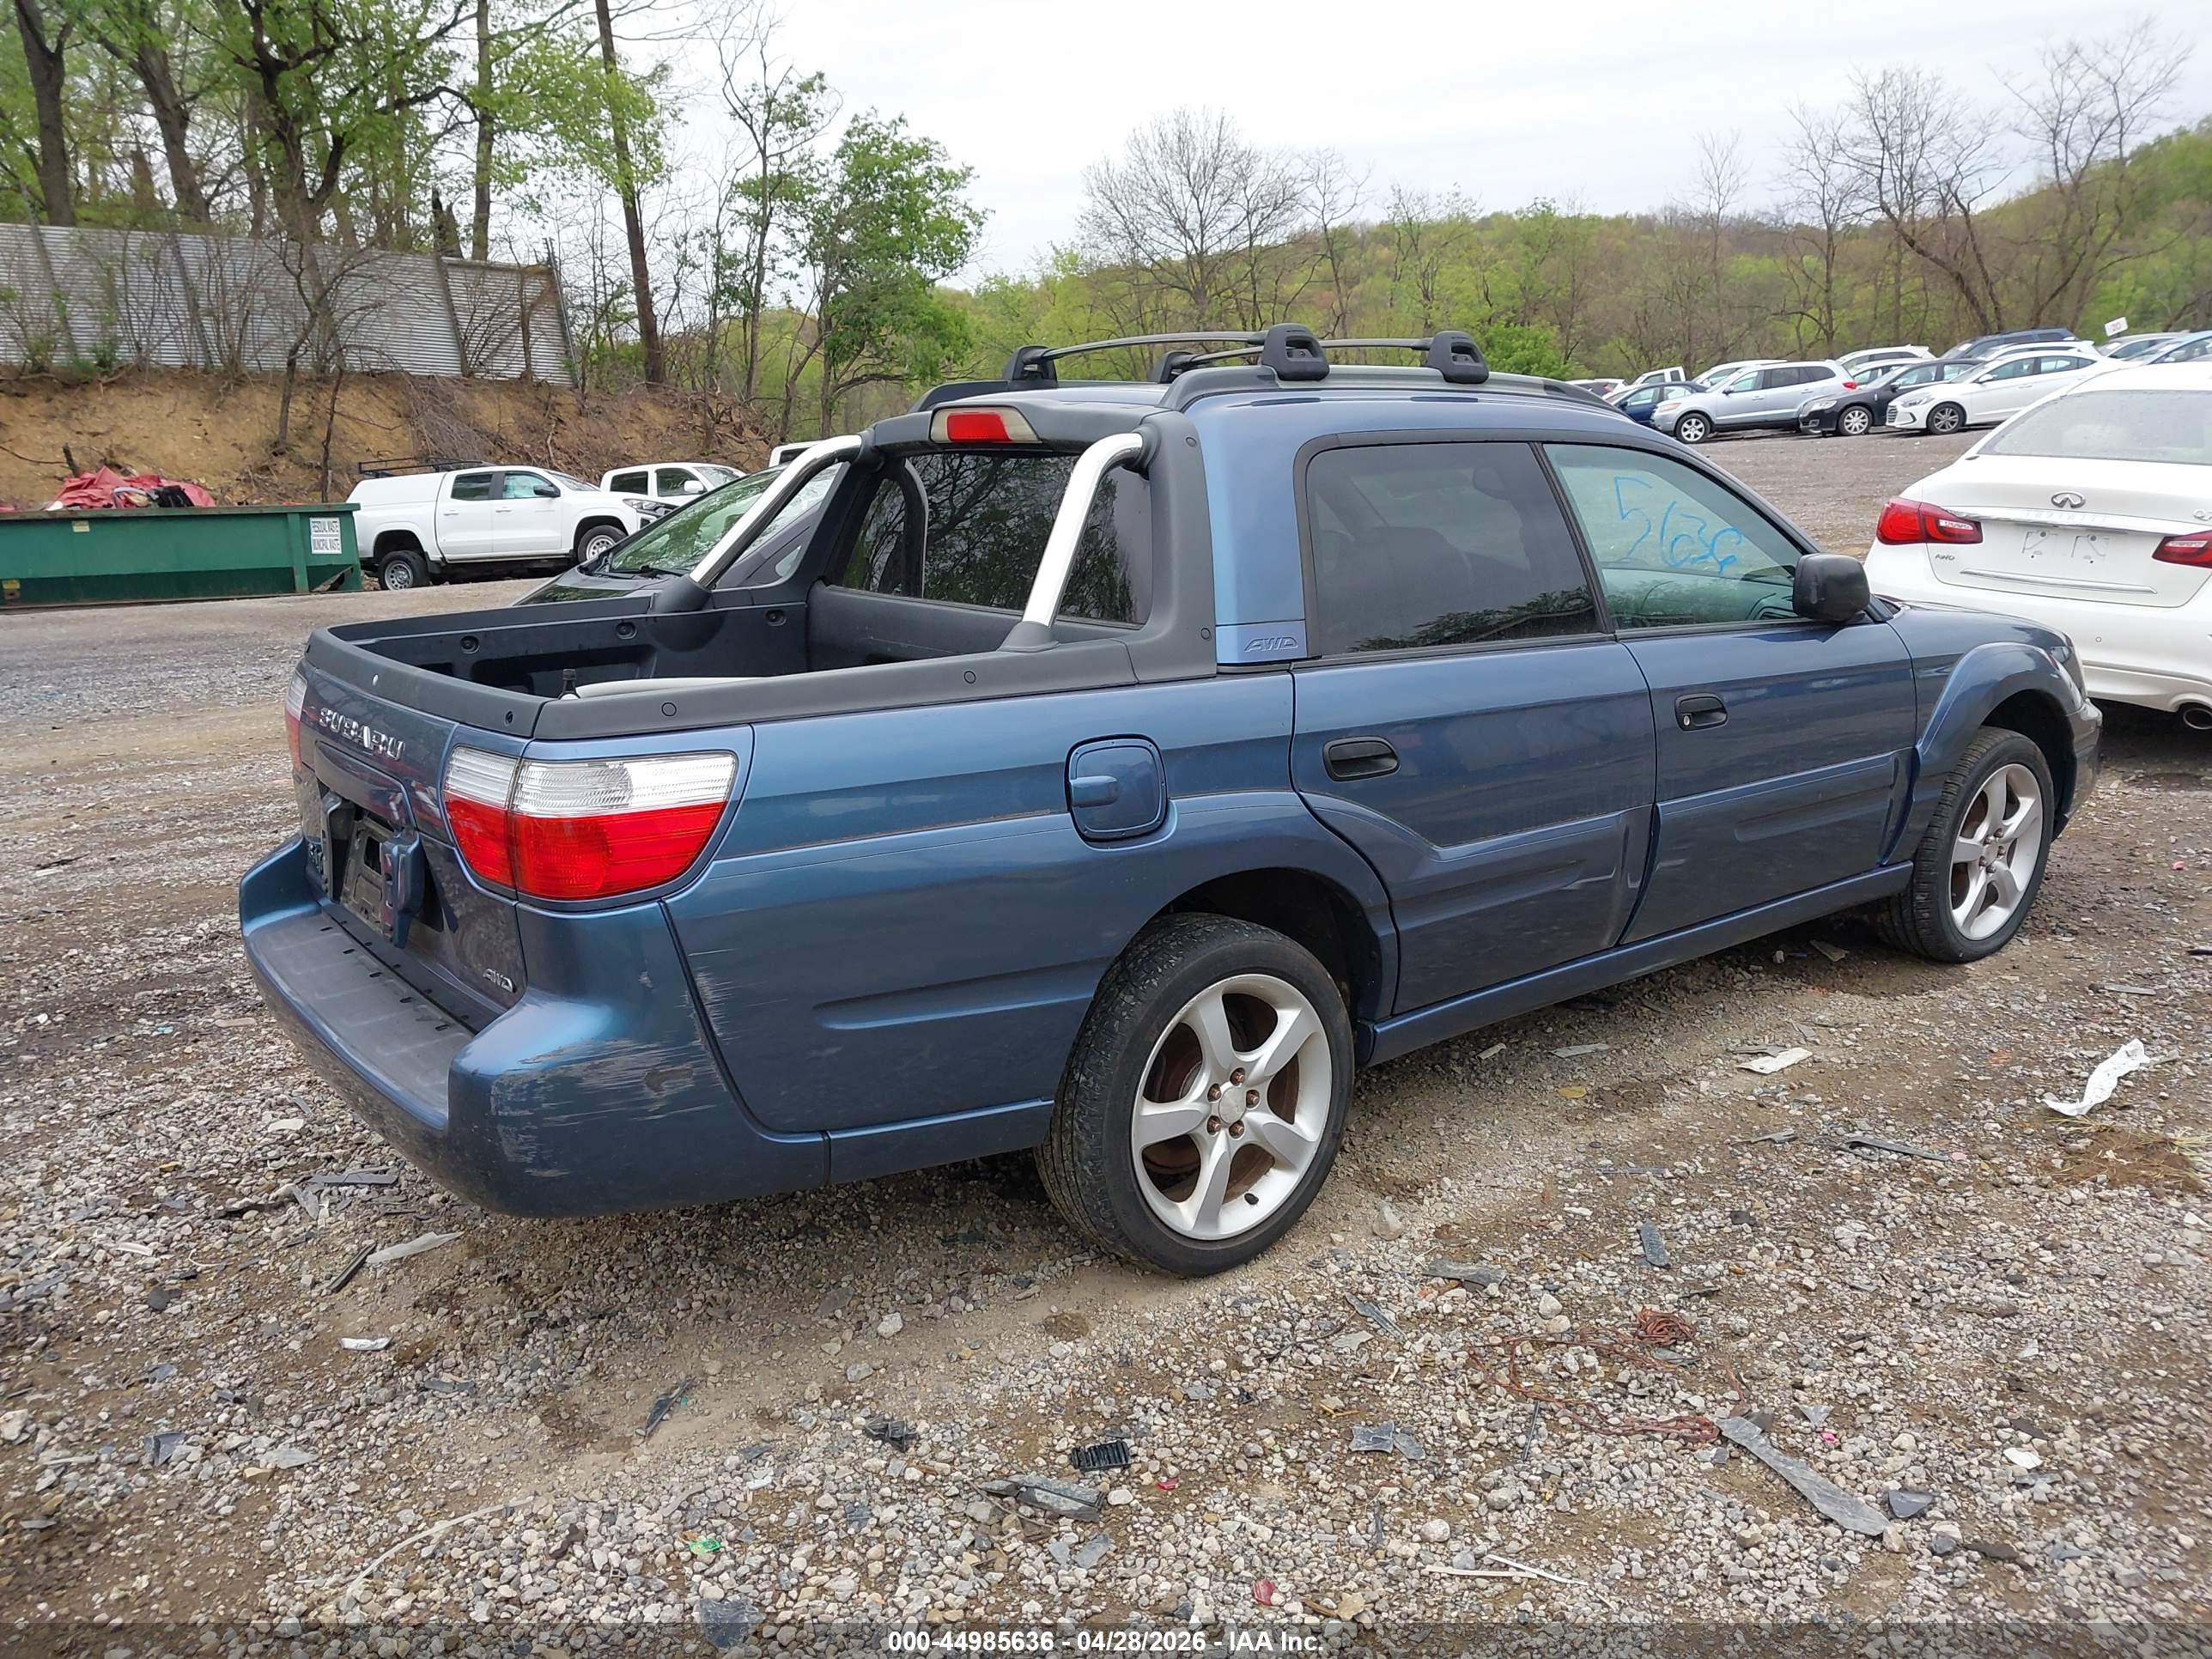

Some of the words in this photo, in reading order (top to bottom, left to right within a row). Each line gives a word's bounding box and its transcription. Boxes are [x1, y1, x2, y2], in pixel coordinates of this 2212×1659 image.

[1243, 636, 1298, 653] AWD
[319, 707, 405, 761] SUBARU
[483, 968, 514, 993] AWD
